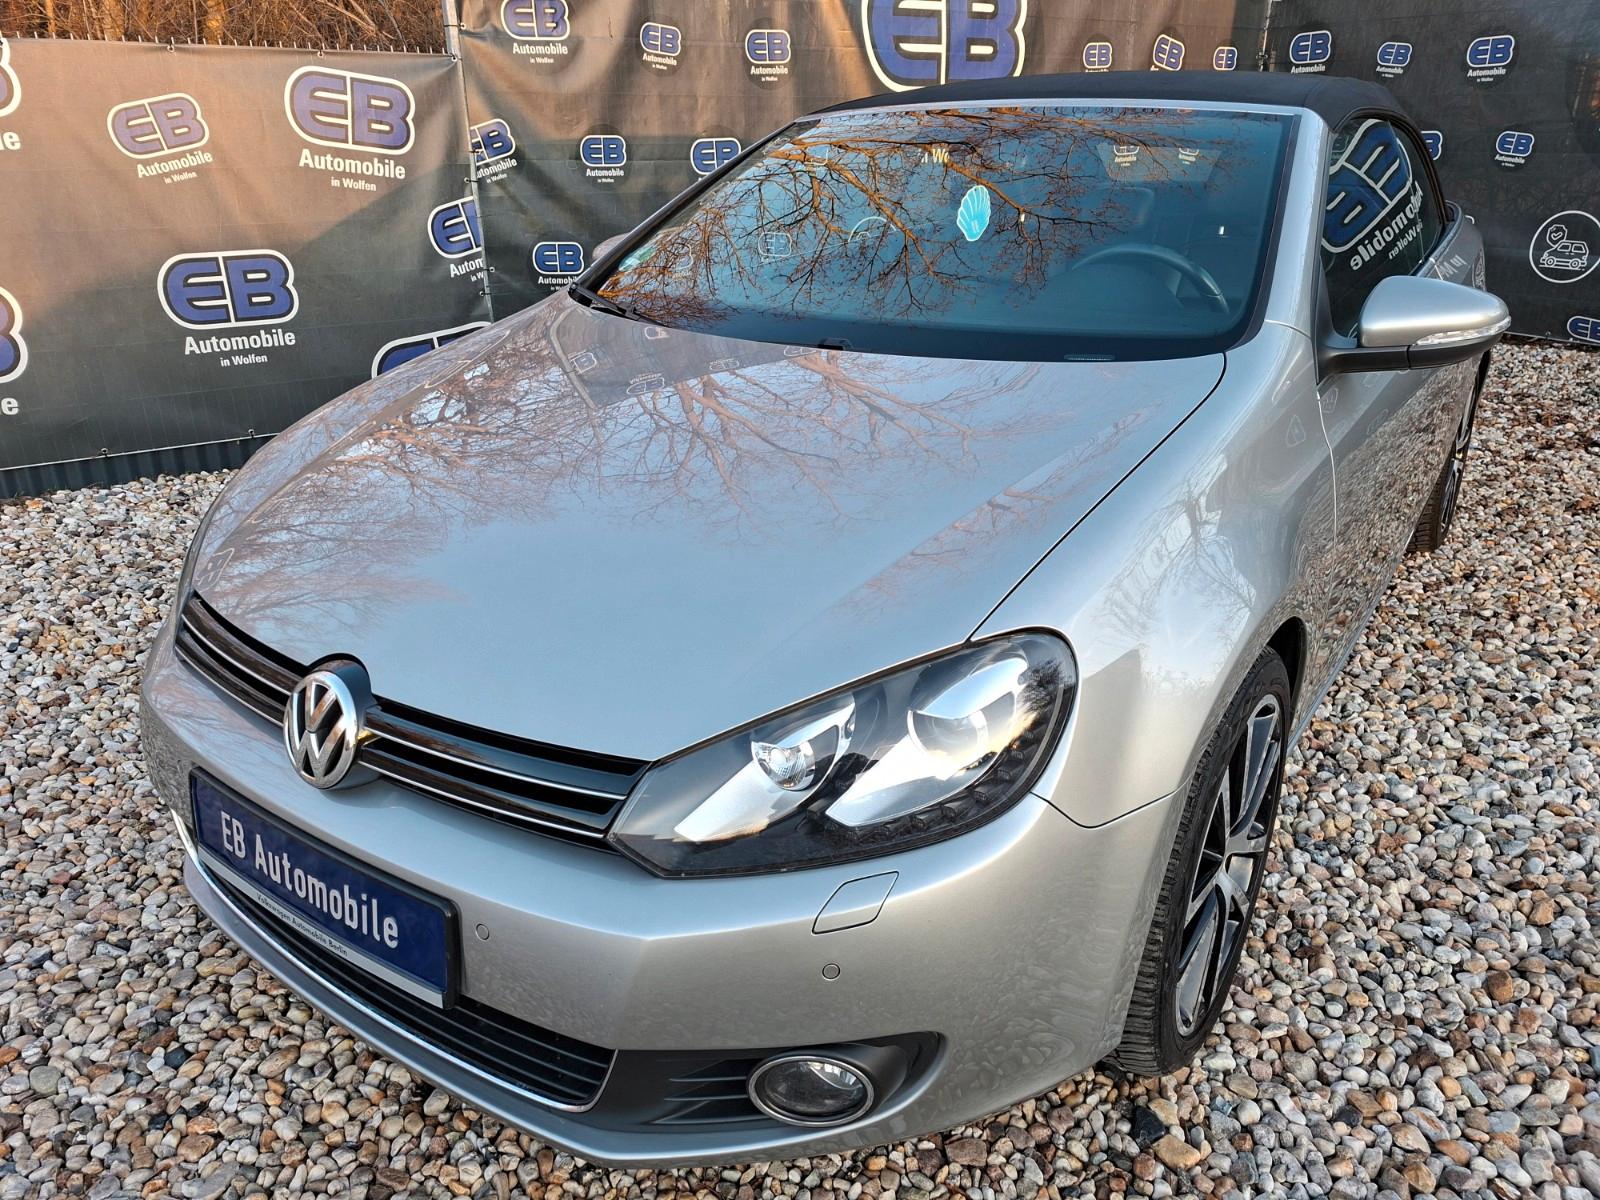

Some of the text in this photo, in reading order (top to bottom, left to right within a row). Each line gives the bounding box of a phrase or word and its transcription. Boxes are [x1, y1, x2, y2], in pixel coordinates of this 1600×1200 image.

[502, 0, 569, 39] EB
[512, 43, 569, 55] Automobile
[641, 23, 680, 55] EB
[746, 30, 790, 63] EB
[865, 0, 1022, 86] EB
[1153, 34, 1185, 70] EB
[1290, 31, 1331, 63] EB
[1467, 35, 1514, 67] EB
[642, 53, 678, 66] Automobile
[1083, 42, 1112, 68] EB
[1213, 47, 1237, 70] EB
[1377, 42, 1412, 66] EB
[750, 65, 789, 75] Automobile
[1290, 64, 1326, 74] Automobile
[1467, 67, 1506, 77] Automobile
[286, 68, 413, 153] EB
[110, 95, 208, 156] EB
[581, 135, 626, 165] EB
[1496, 132, 1534, 156] EB
[137, 151, 213, 178] Automobile
[299, 148, 406, 179] Automobile
[477, 158, 518, 178] utomobile
[586, 168, 624, 177] Automobile
[331, 177, 377, 191] in Wolfen
[533, 242, 583, 274] EB
[160, 252, 297, 327] EB
[184, 328, 296, 355] Automobile
[220, 354, 268, 367] in Wolfen
[220, 810, 399, 949] EB Automobile
